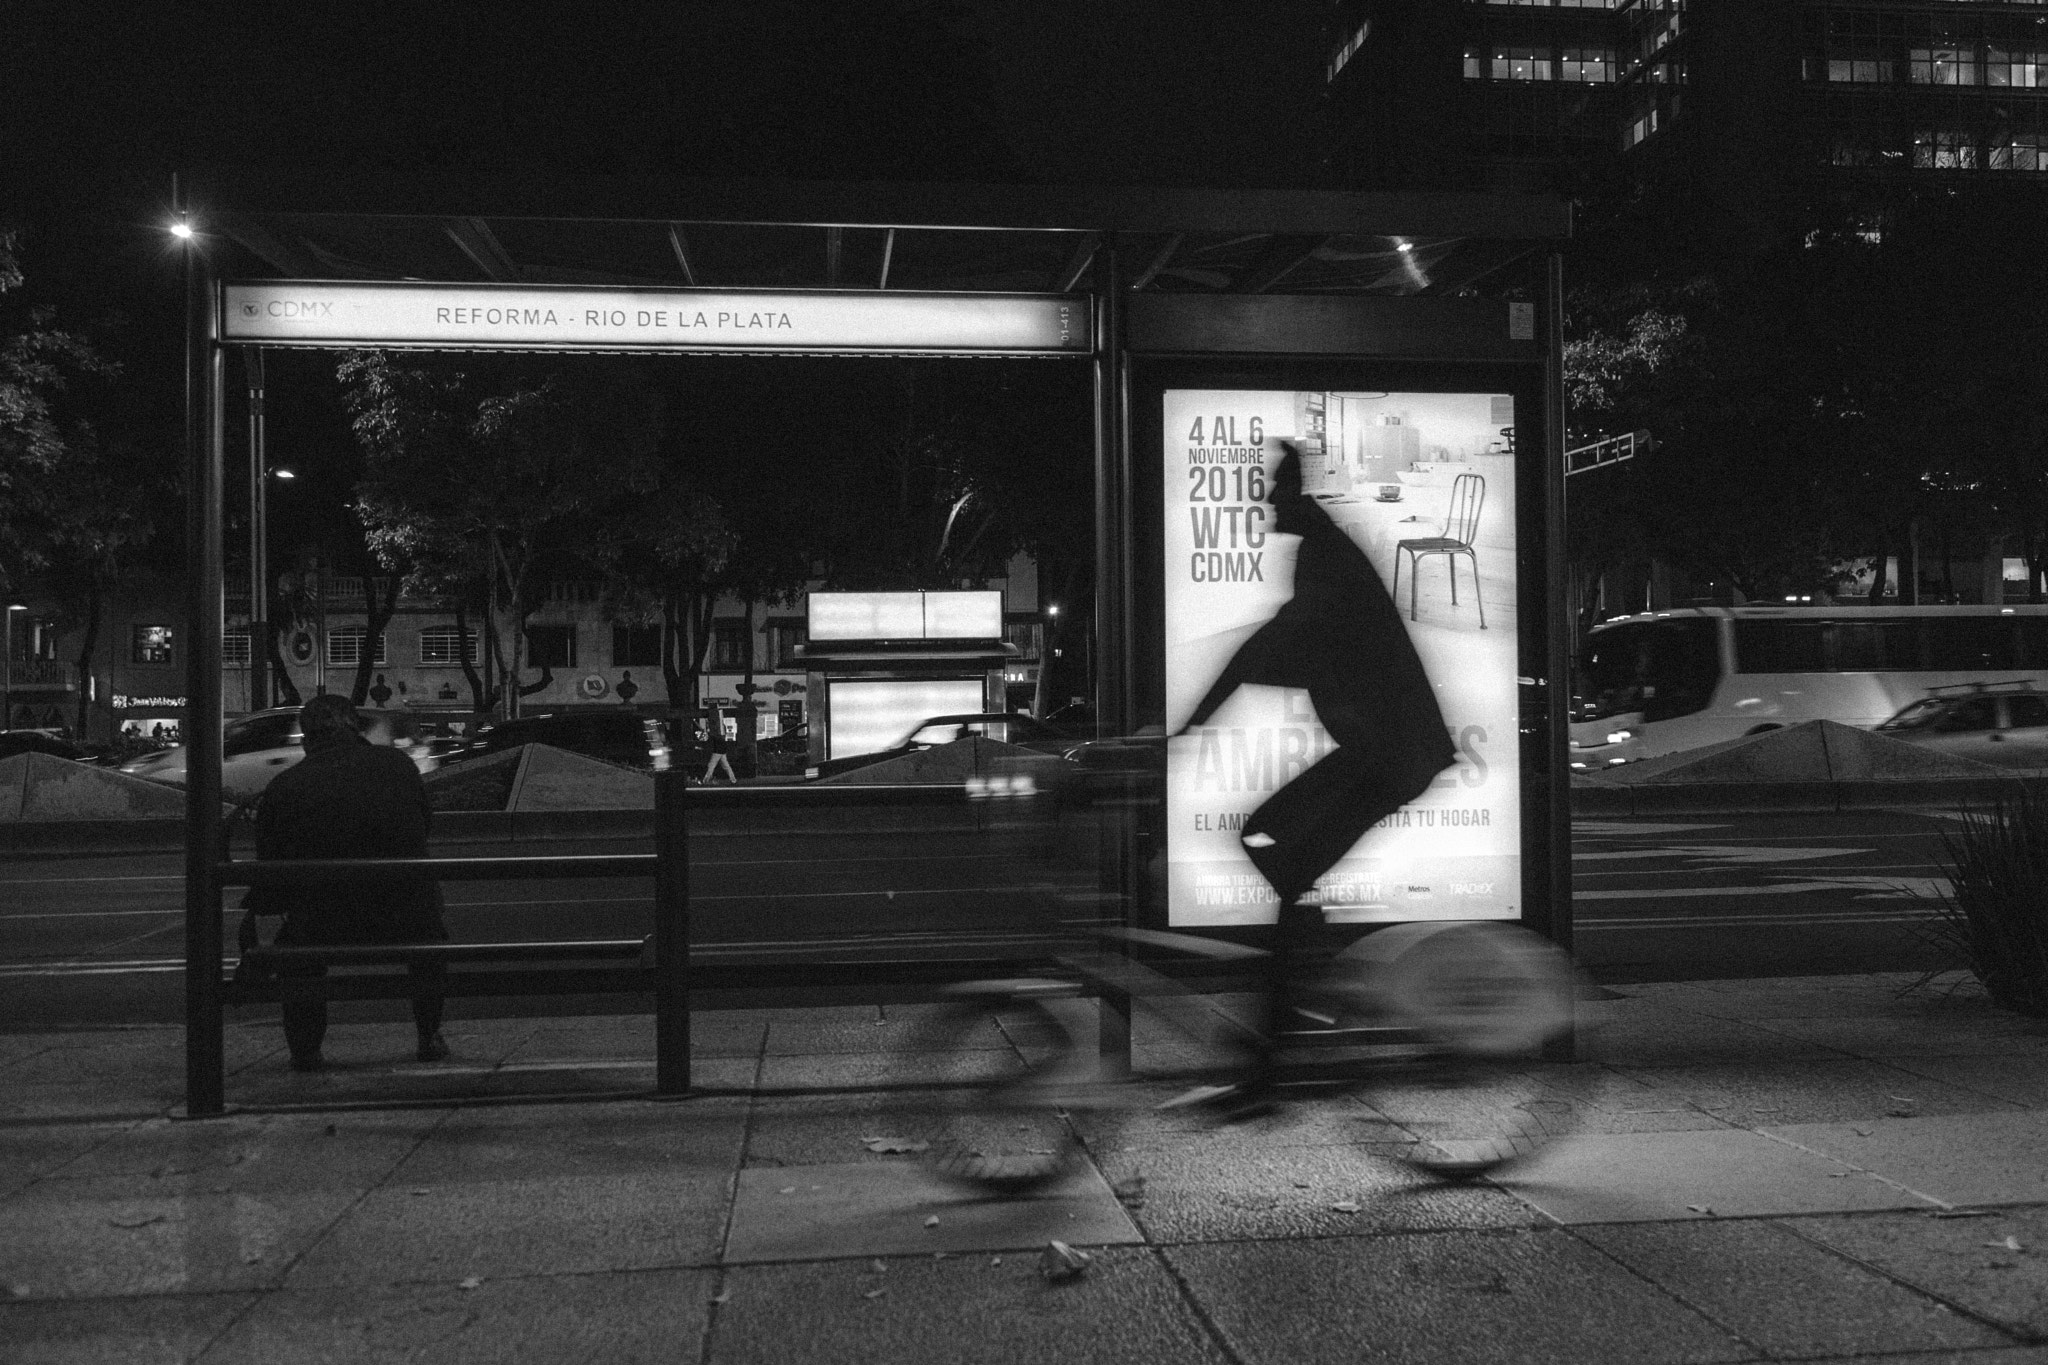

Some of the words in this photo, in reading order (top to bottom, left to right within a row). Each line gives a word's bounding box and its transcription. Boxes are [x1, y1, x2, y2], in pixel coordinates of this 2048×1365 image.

[267, 300, 334, 318] CDMX
[437, 307, 558, 325] REFORMA
[585, 310, 626, 327] RIO
[637, 311, 666, 327] DE
[678, 312, 708, 328] LA
[718, 312, 792, 329] PLATA
[1060, 306, 1070, 341] 01-413
[1189, 416, 1205, 446] 4
[1212, 416, 1242, 446] AL
[1249, 416, 1264, 446] 6
[1188, 448, 1264, 465] NOVIEMBRE
[1189, 466, 1265, 502] 2016
[1190, 506, 1265, 549] WTC
[1191, 552, 1264, 582] CDMX
[1193, 724, 1489, 792] AMBIS
[1194, 813, 1213, 832] EL
[1417, 810, 1435, 827] TU
[1441, 809, 1491, 827] HOGAR
[1232, 875, 1265, 886] TIEMPO
